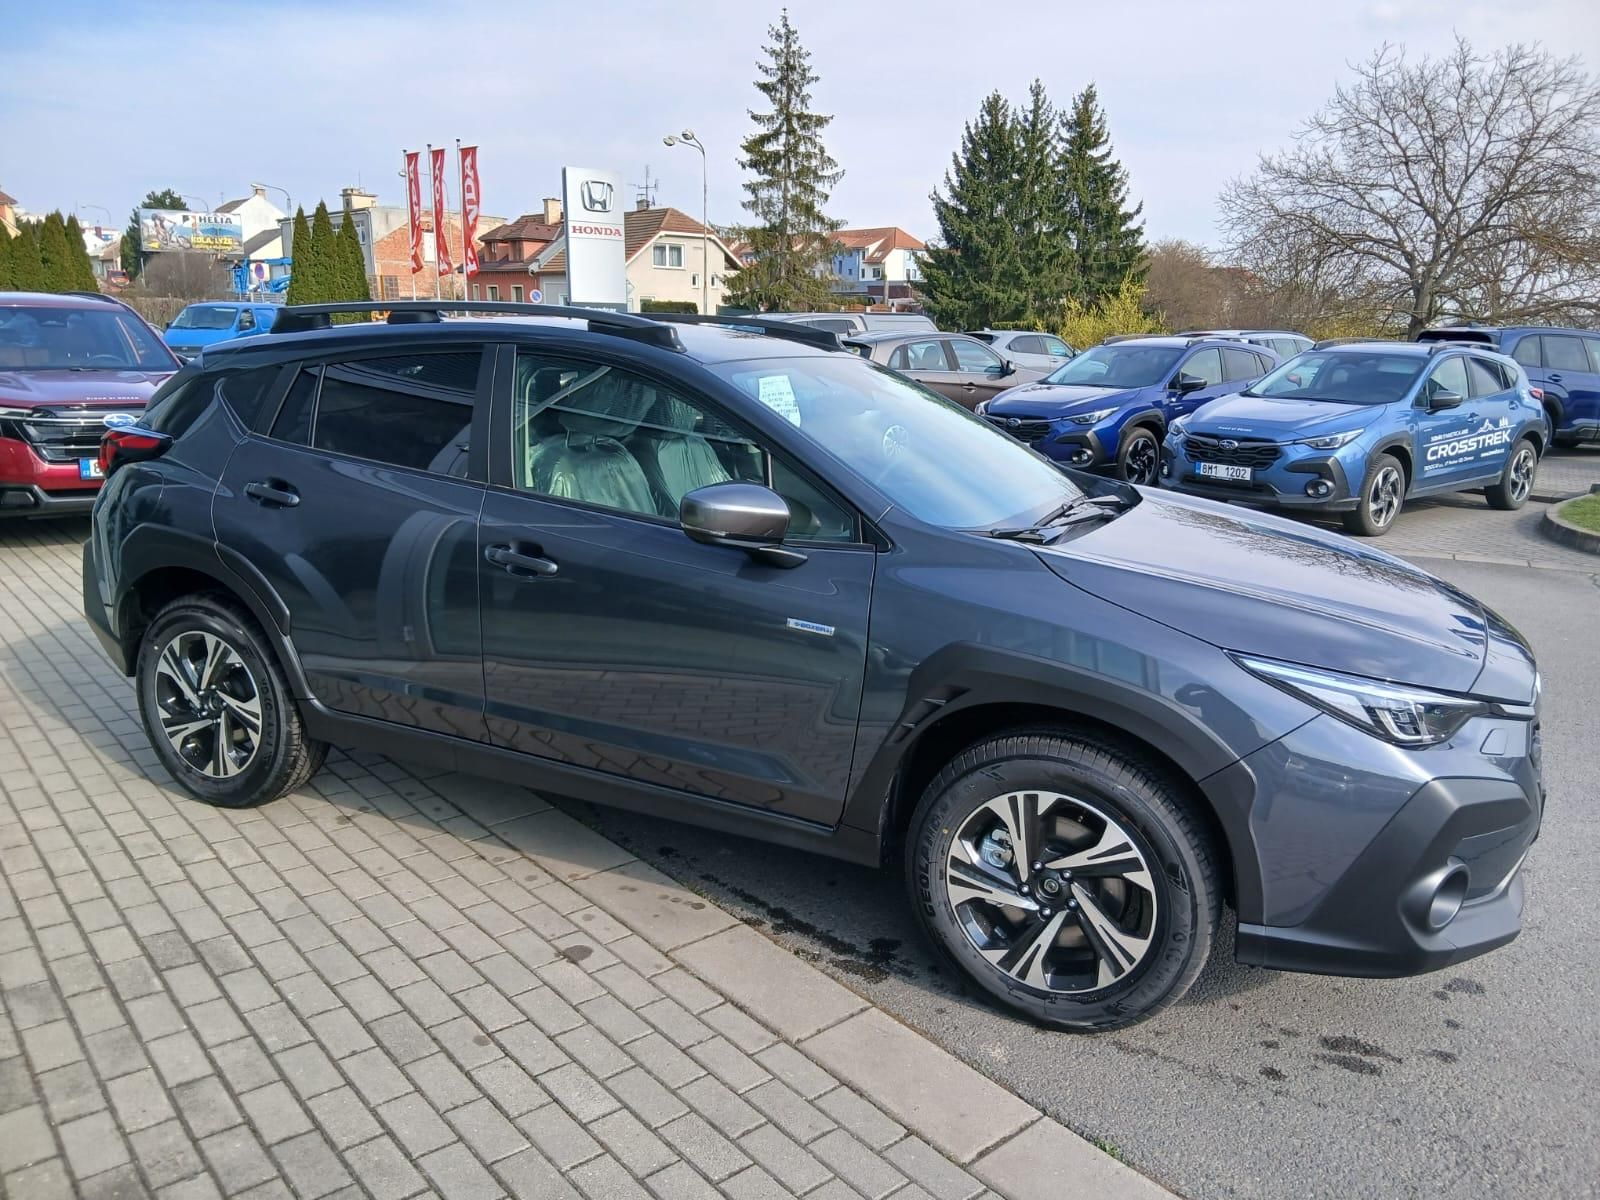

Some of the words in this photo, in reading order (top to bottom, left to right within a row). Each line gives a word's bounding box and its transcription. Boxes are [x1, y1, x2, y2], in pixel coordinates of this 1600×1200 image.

[199, 216, 232, 224] HELIA
[571, 225, 622, 237] HONDA
[1426, 429, 1513, 461] CROSSTREK
[1225, 466, 1248, 479] 1202
